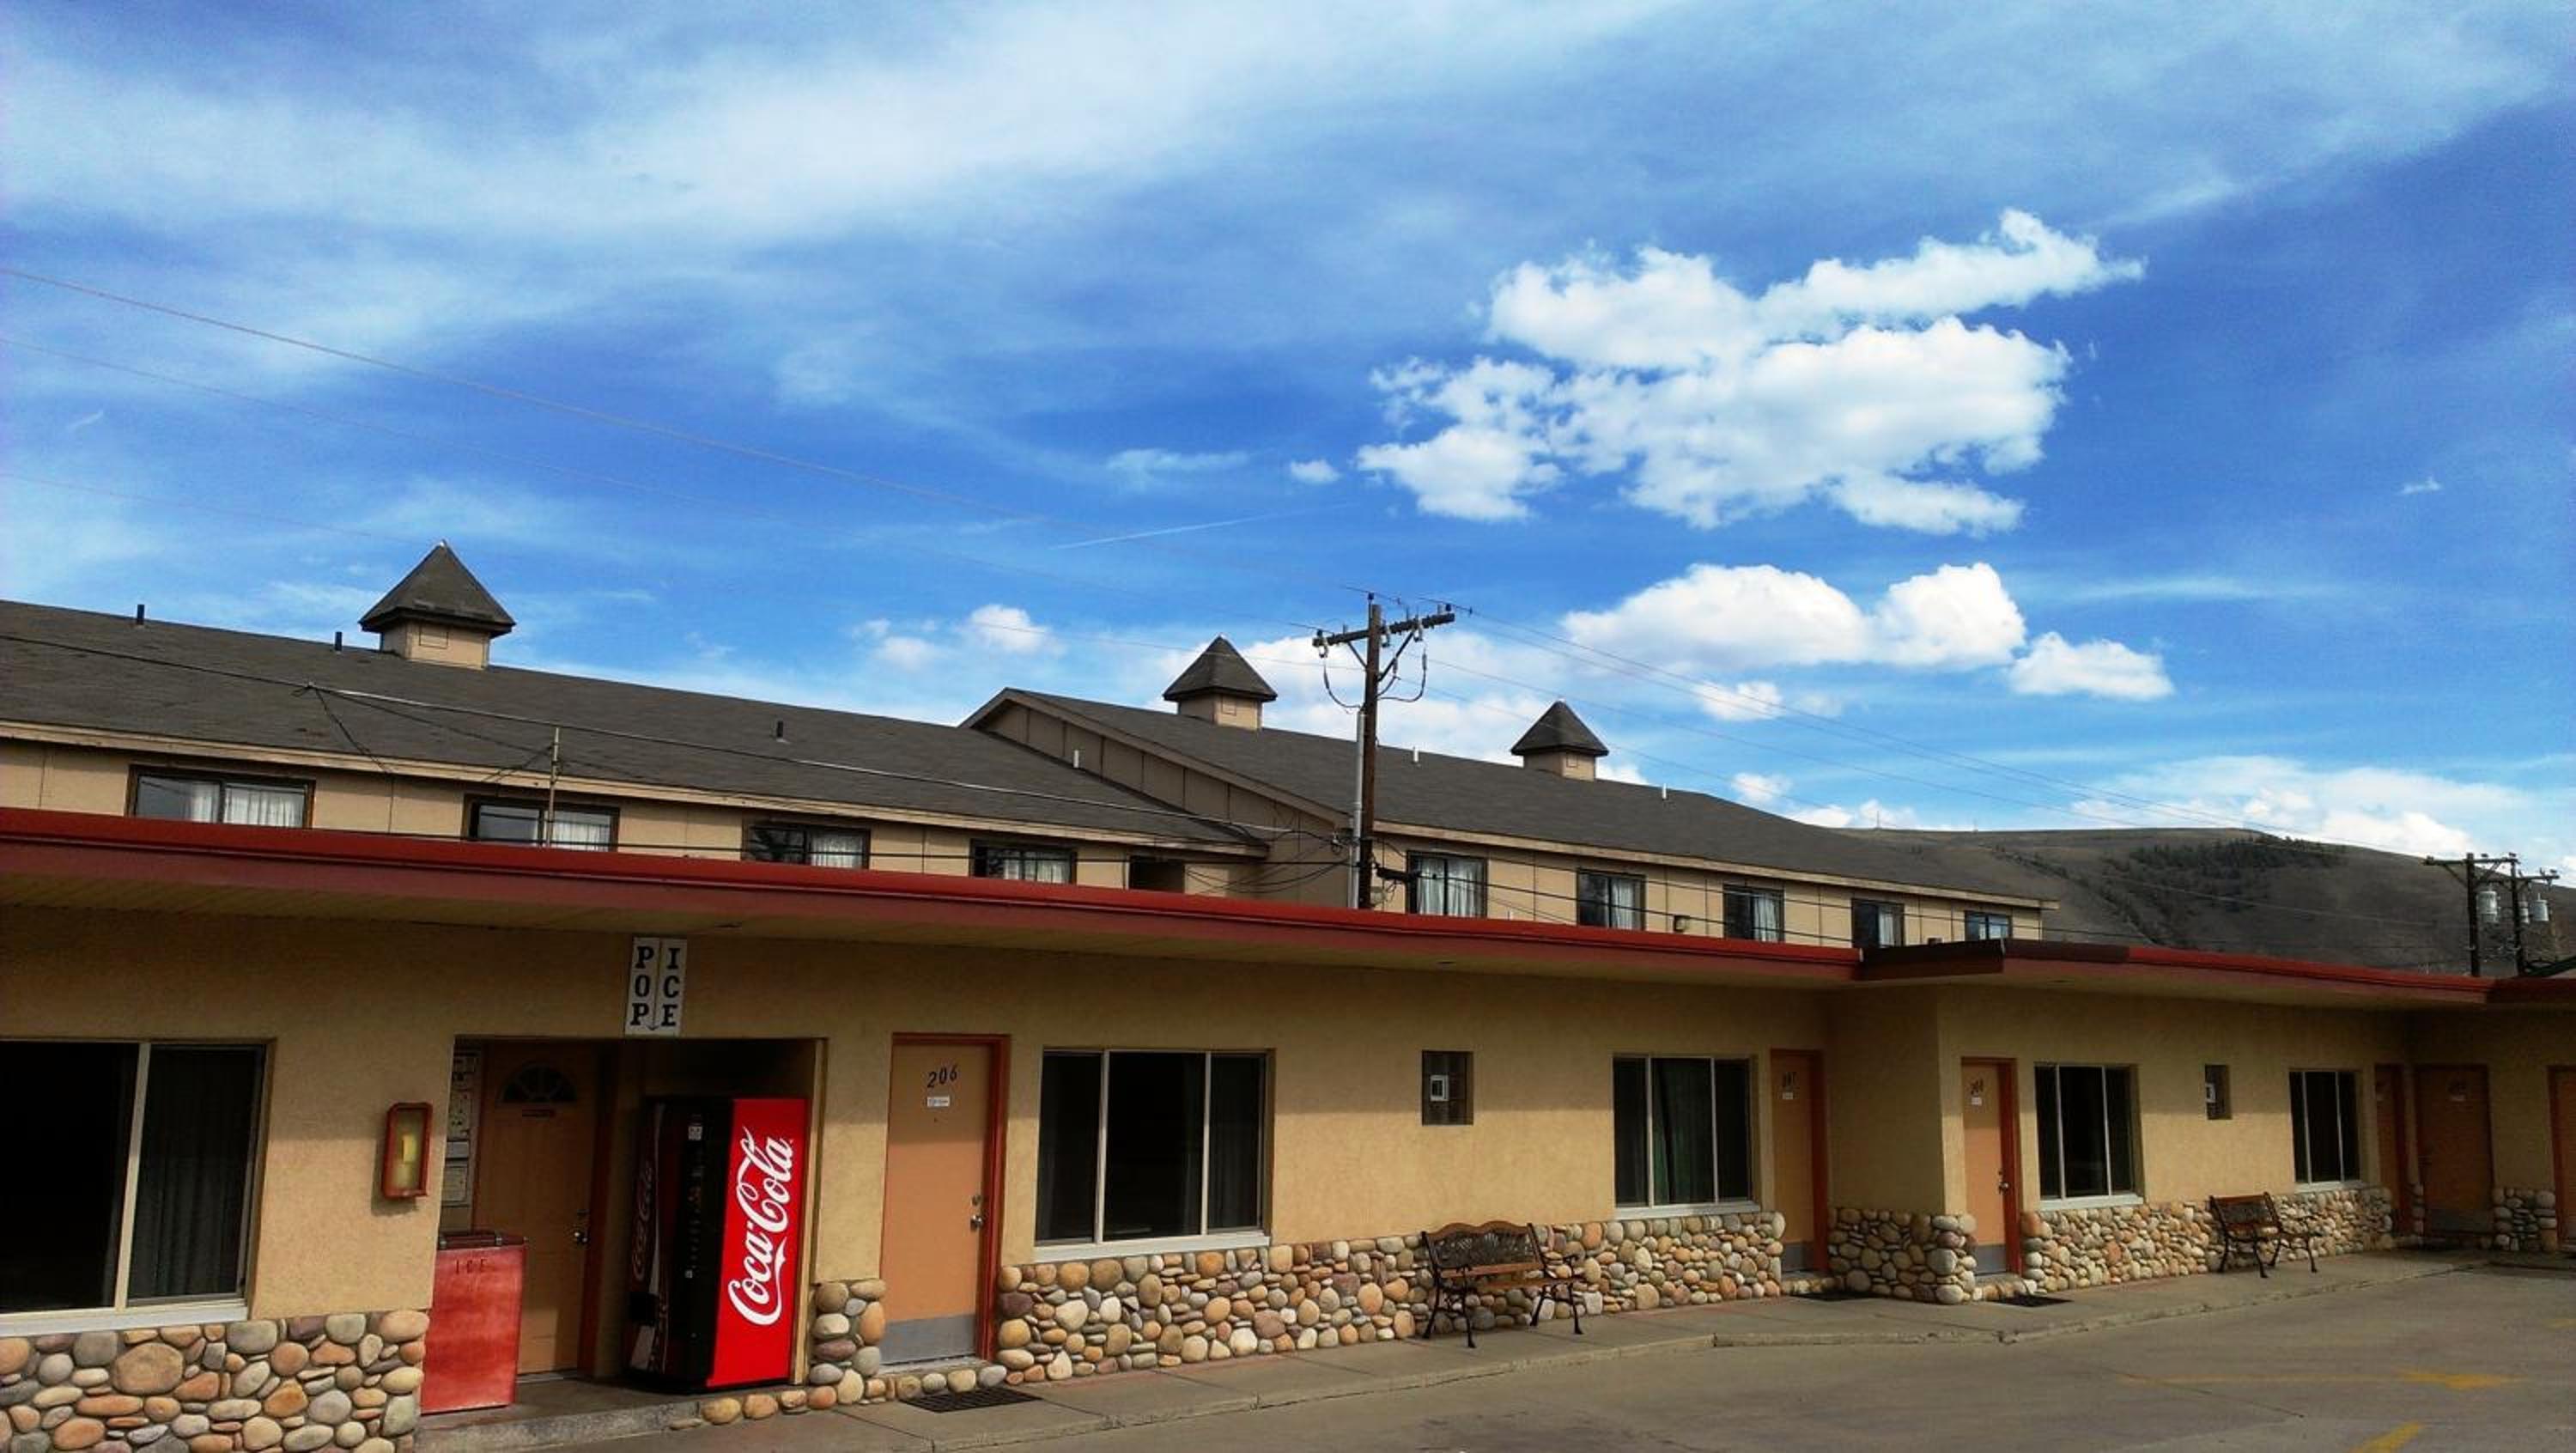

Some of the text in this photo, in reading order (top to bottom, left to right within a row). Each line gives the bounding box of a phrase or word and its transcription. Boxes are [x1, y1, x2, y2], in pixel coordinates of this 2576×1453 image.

[630, 945, 654, 1026] POP
[660, 947, 681, 1027] ICE
[927, 1064, 959, 1089] 206
